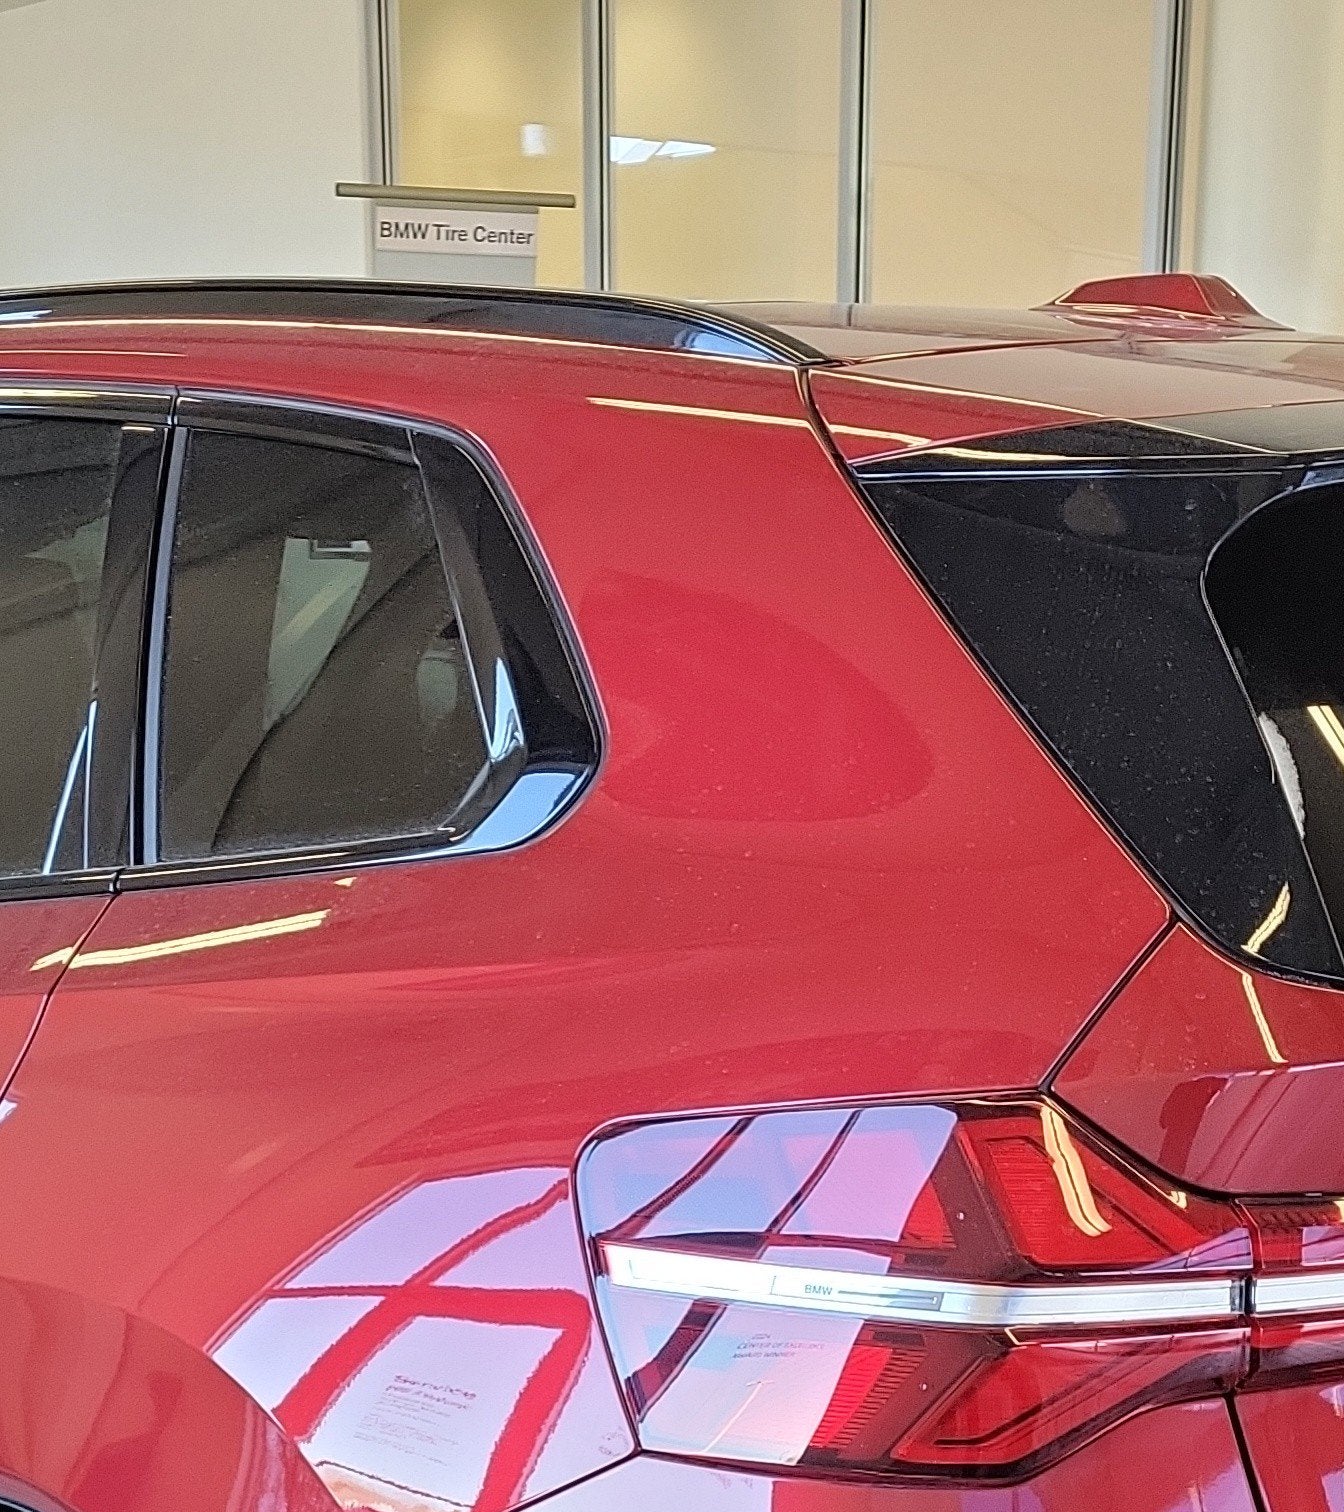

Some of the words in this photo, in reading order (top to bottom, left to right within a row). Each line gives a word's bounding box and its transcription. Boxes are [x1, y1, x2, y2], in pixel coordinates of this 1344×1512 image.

[380, 221, 429, 239] BMW
[432, 223, 468, 242] Tire
[473, 225, 535, 245] Center
[805, 1284, 833, 1296] BMW
